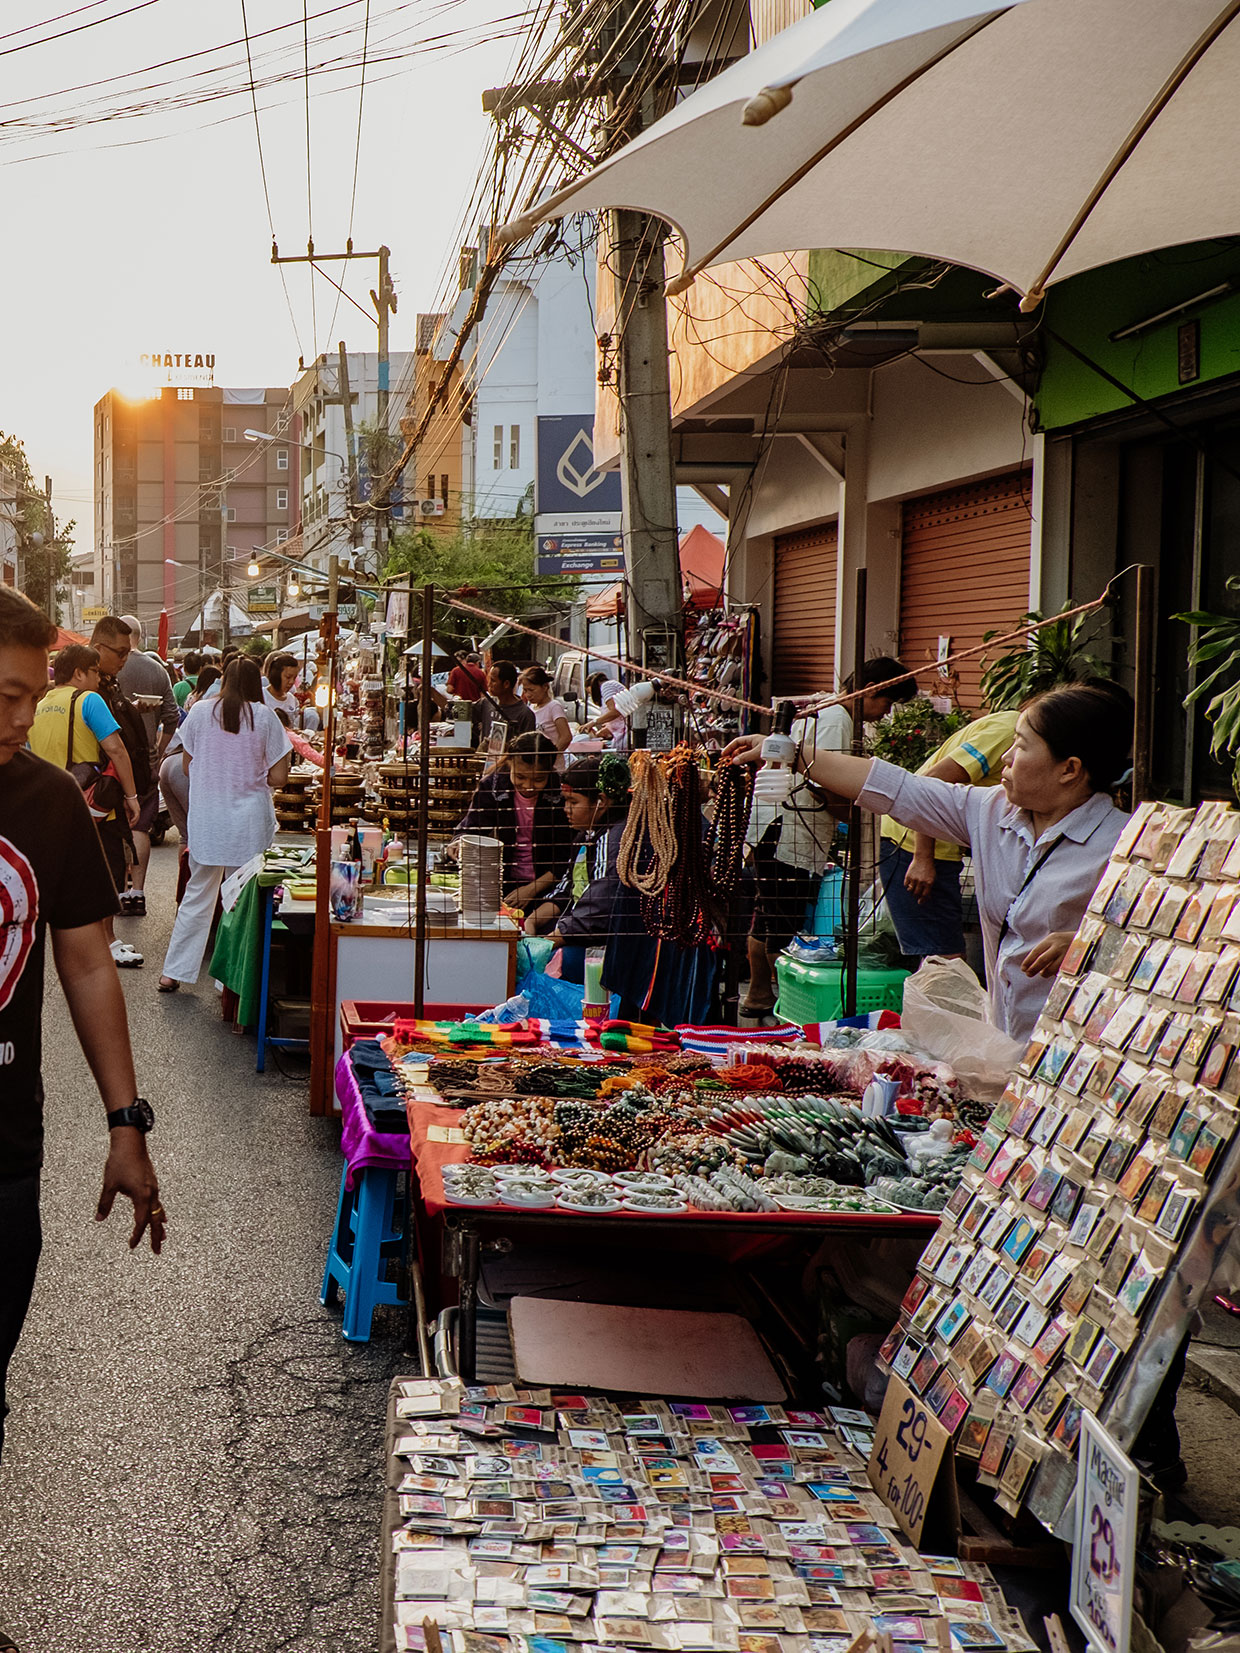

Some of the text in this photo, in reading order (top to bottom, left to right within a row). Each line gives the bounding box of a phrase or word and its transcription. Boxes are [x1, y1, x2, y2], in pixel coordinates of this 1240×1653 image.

[561, 561, 594, 570] Exchange
[876, 1437, 889, 1478] 4
[887, 1476, 902, 1508] for
